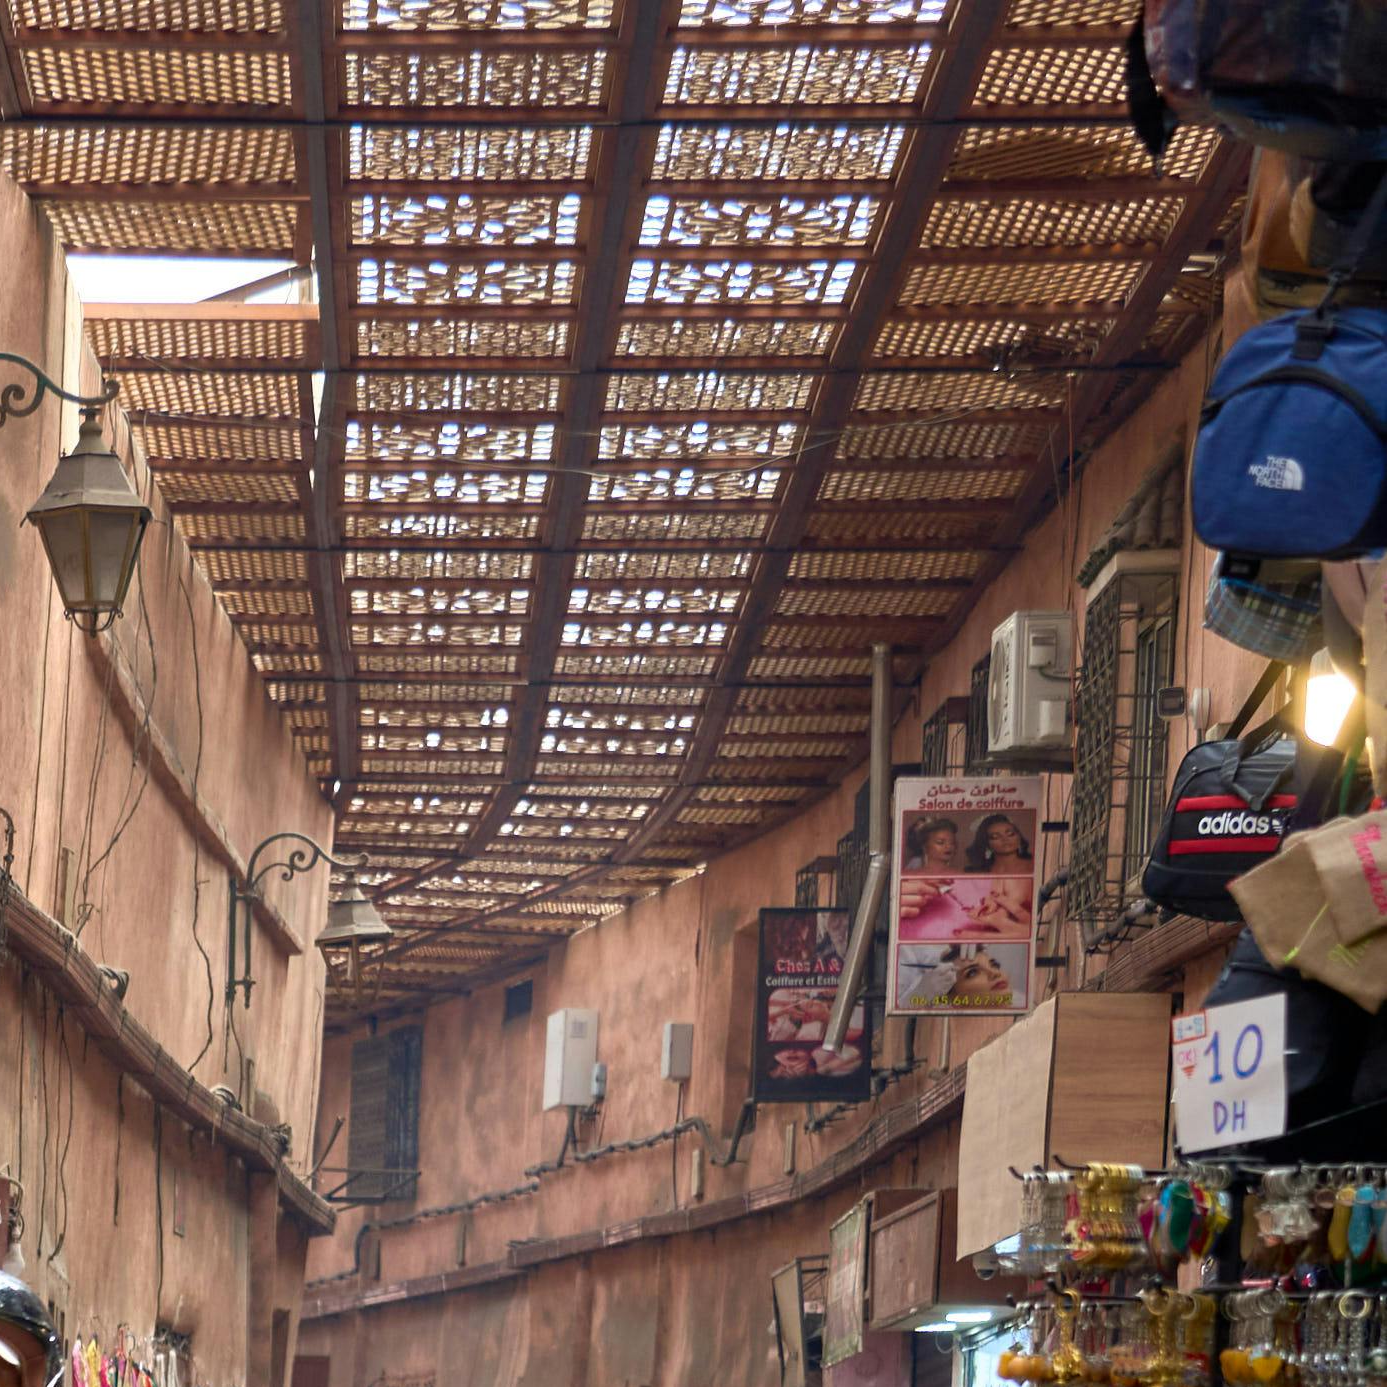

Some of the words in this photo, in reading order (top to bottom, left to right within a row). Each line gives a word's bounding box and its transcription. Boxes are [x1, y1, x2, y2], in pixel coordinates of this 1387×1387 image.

[1267, 456, 1287, 468] THE
[1248, 464, 1285, 480] NORTH
[1256, 477, 1285, 489] FACE
[970, 784, 1017, 797] صالون
[919, 798, 953, 810] Salon
[957, 797, 972, 809] de
[976, 796, 1025, 809] coiffure
[1198, 812, 1269, 835] adidas
[775, 959, 811, 974] Chez
[814, 958, 826, 973] A
[828, 958, 841, 973] &
[765, 975, 804, 987] Coiffure
[805, 976, 814, 986] et
[1204, 1023, 1264, 1084] 10
[1214, 1100, 1246, 1135] DH
